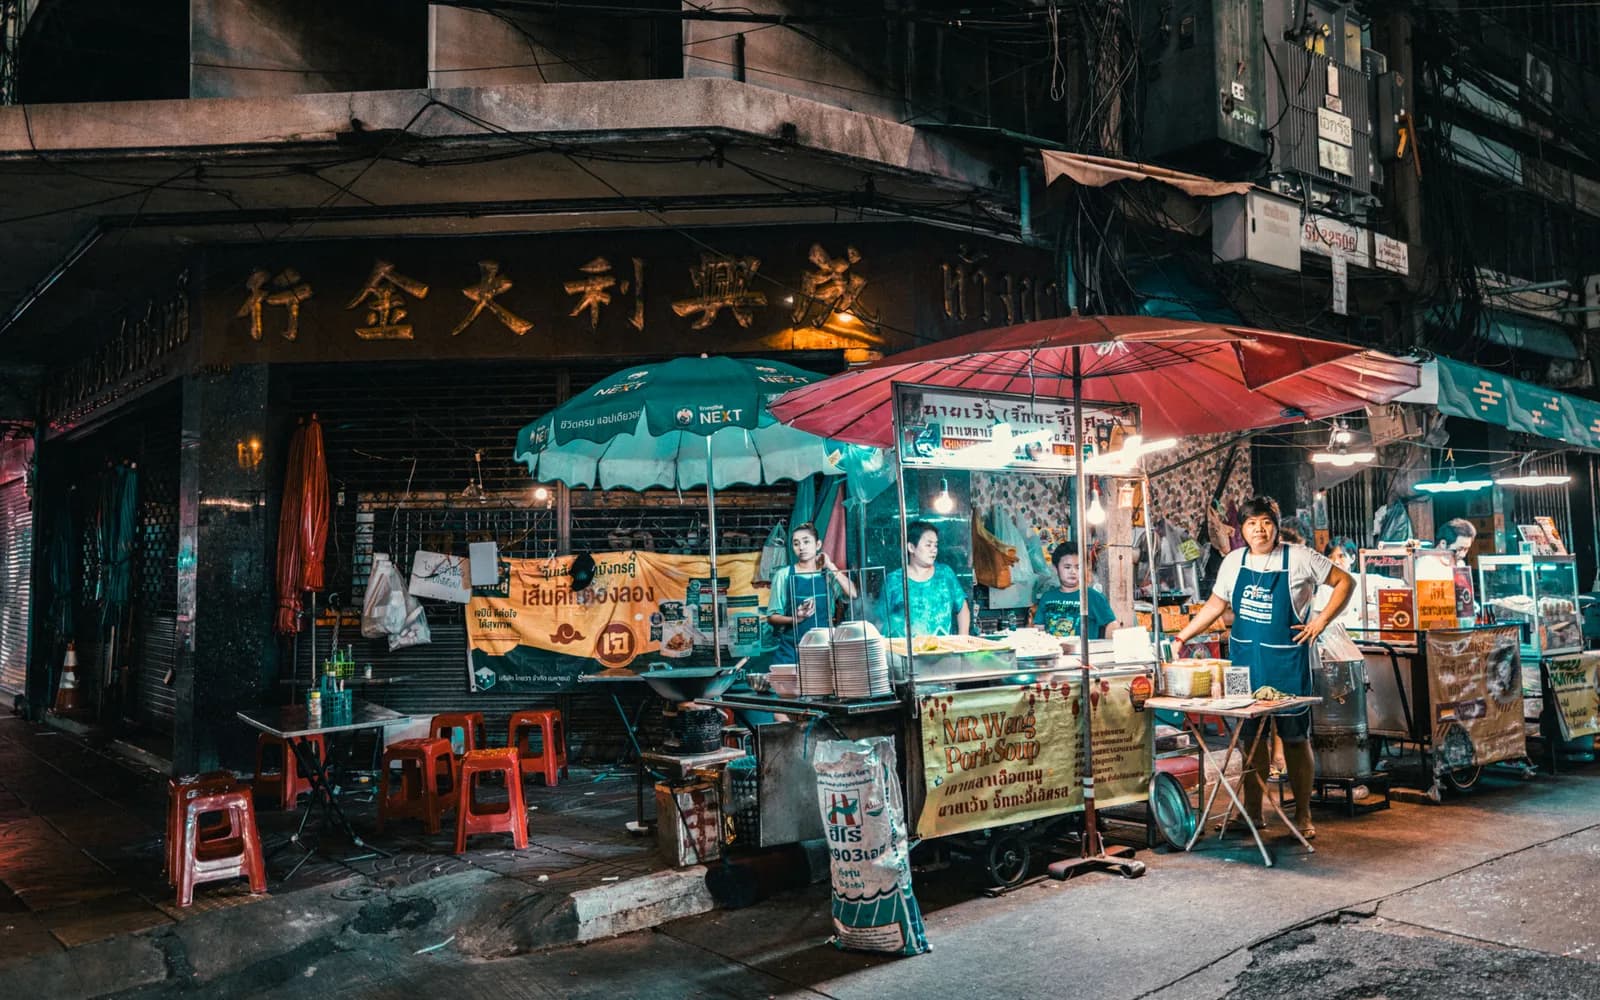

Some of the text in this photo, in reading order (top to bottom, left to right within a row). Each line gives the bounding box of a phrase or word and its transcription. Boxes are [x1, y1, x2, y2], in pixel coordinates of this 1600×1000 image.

[560, 417, 595, 429] ชีวิตครบ
[700, 409, 742, 425] NEXT
[944, 742, 993, 773] Pork
[991, 738, 1041, 766] Soup
[944, 769, 1043, 797] เกาเหลาเลือดหมู
